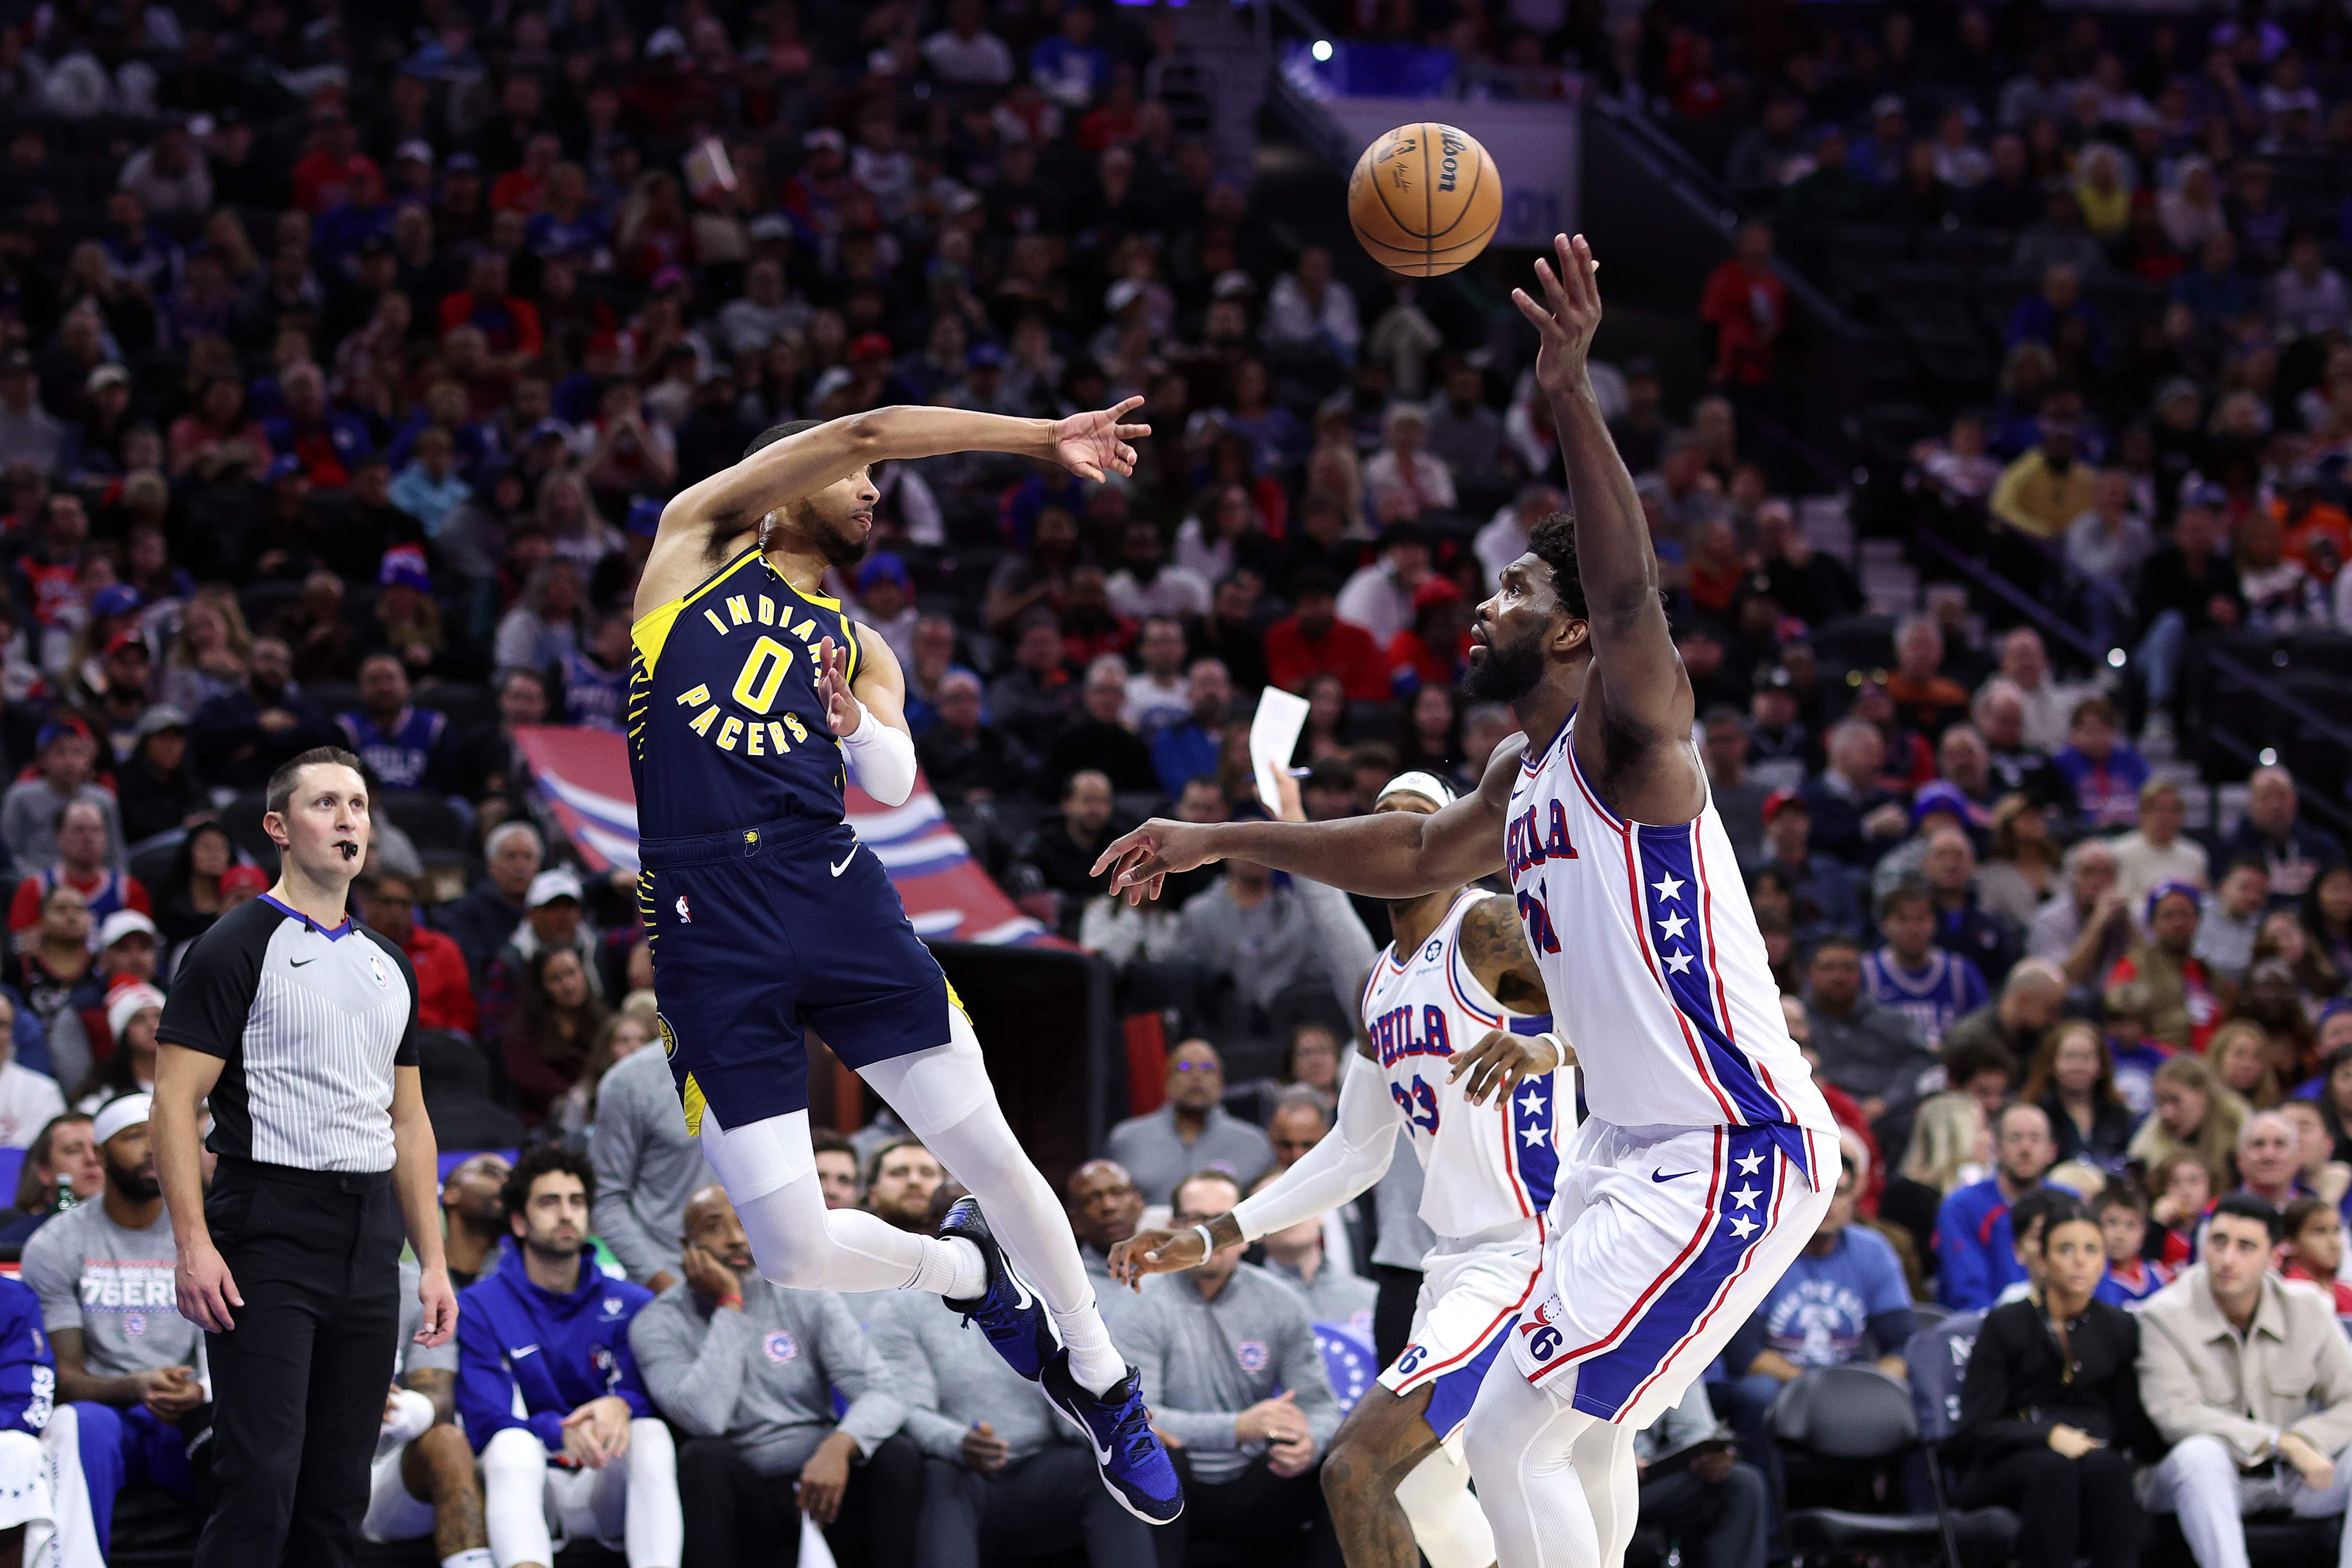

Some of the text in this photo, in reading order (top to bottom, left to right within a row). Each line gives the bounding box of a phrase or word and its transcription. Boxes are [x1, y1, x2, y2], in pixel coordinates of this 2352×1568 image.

[732, 635, 794, 715] 0
[676, 683, 809, 756] PACERS
[1506, 799, 1579, 886] HILA
[1518, 1302, 1563, 1362] 76
